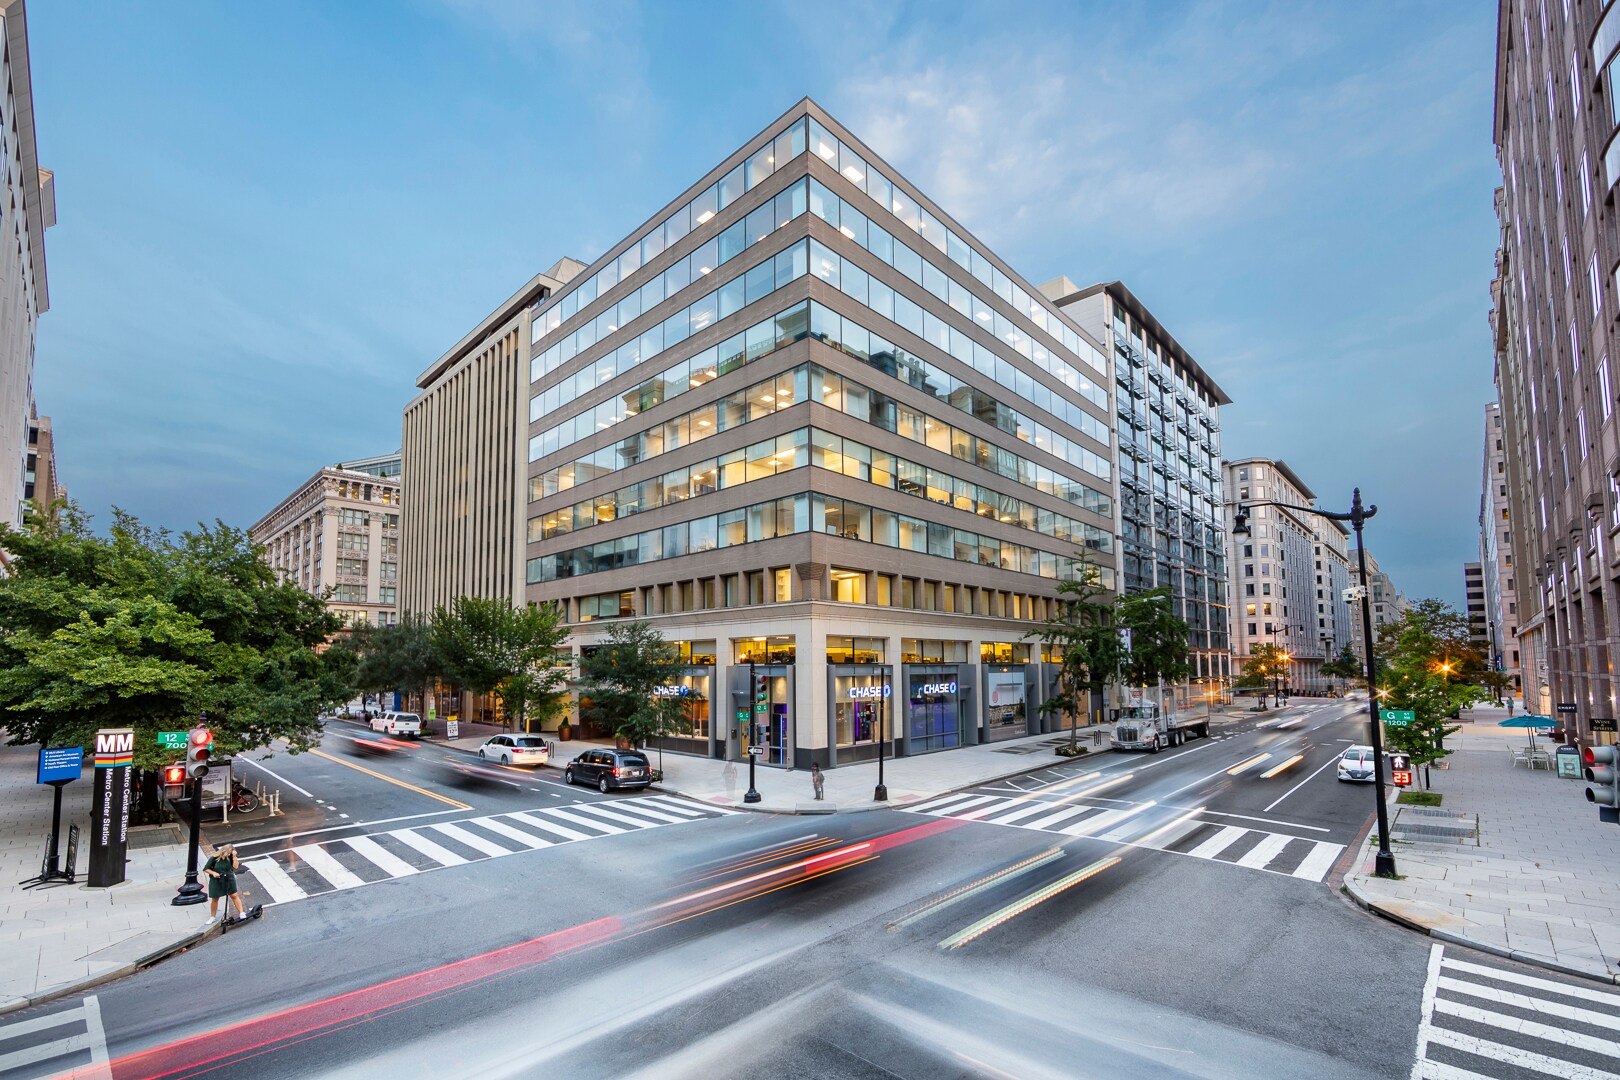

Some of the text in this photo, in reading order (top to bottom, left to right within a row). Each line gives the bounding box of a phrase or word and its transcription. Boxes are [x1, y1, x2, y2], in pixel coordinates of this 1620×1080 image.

[653, 685, 680, 696] CHASE
[849, 686, 882, 699] CHASE
[923, 683, 950, 694] CHASE
[1386, 711, 1396, 720] G
[97, 734, 116, 753] M
[116, 733, 134, 752] M
[165, 733, 178, 742] 12
[1393, 772, 1409, 783] 23
[101, 768, 114, 846] Metro Center Station
[120, 766, 132, 842] Metro Center Station
